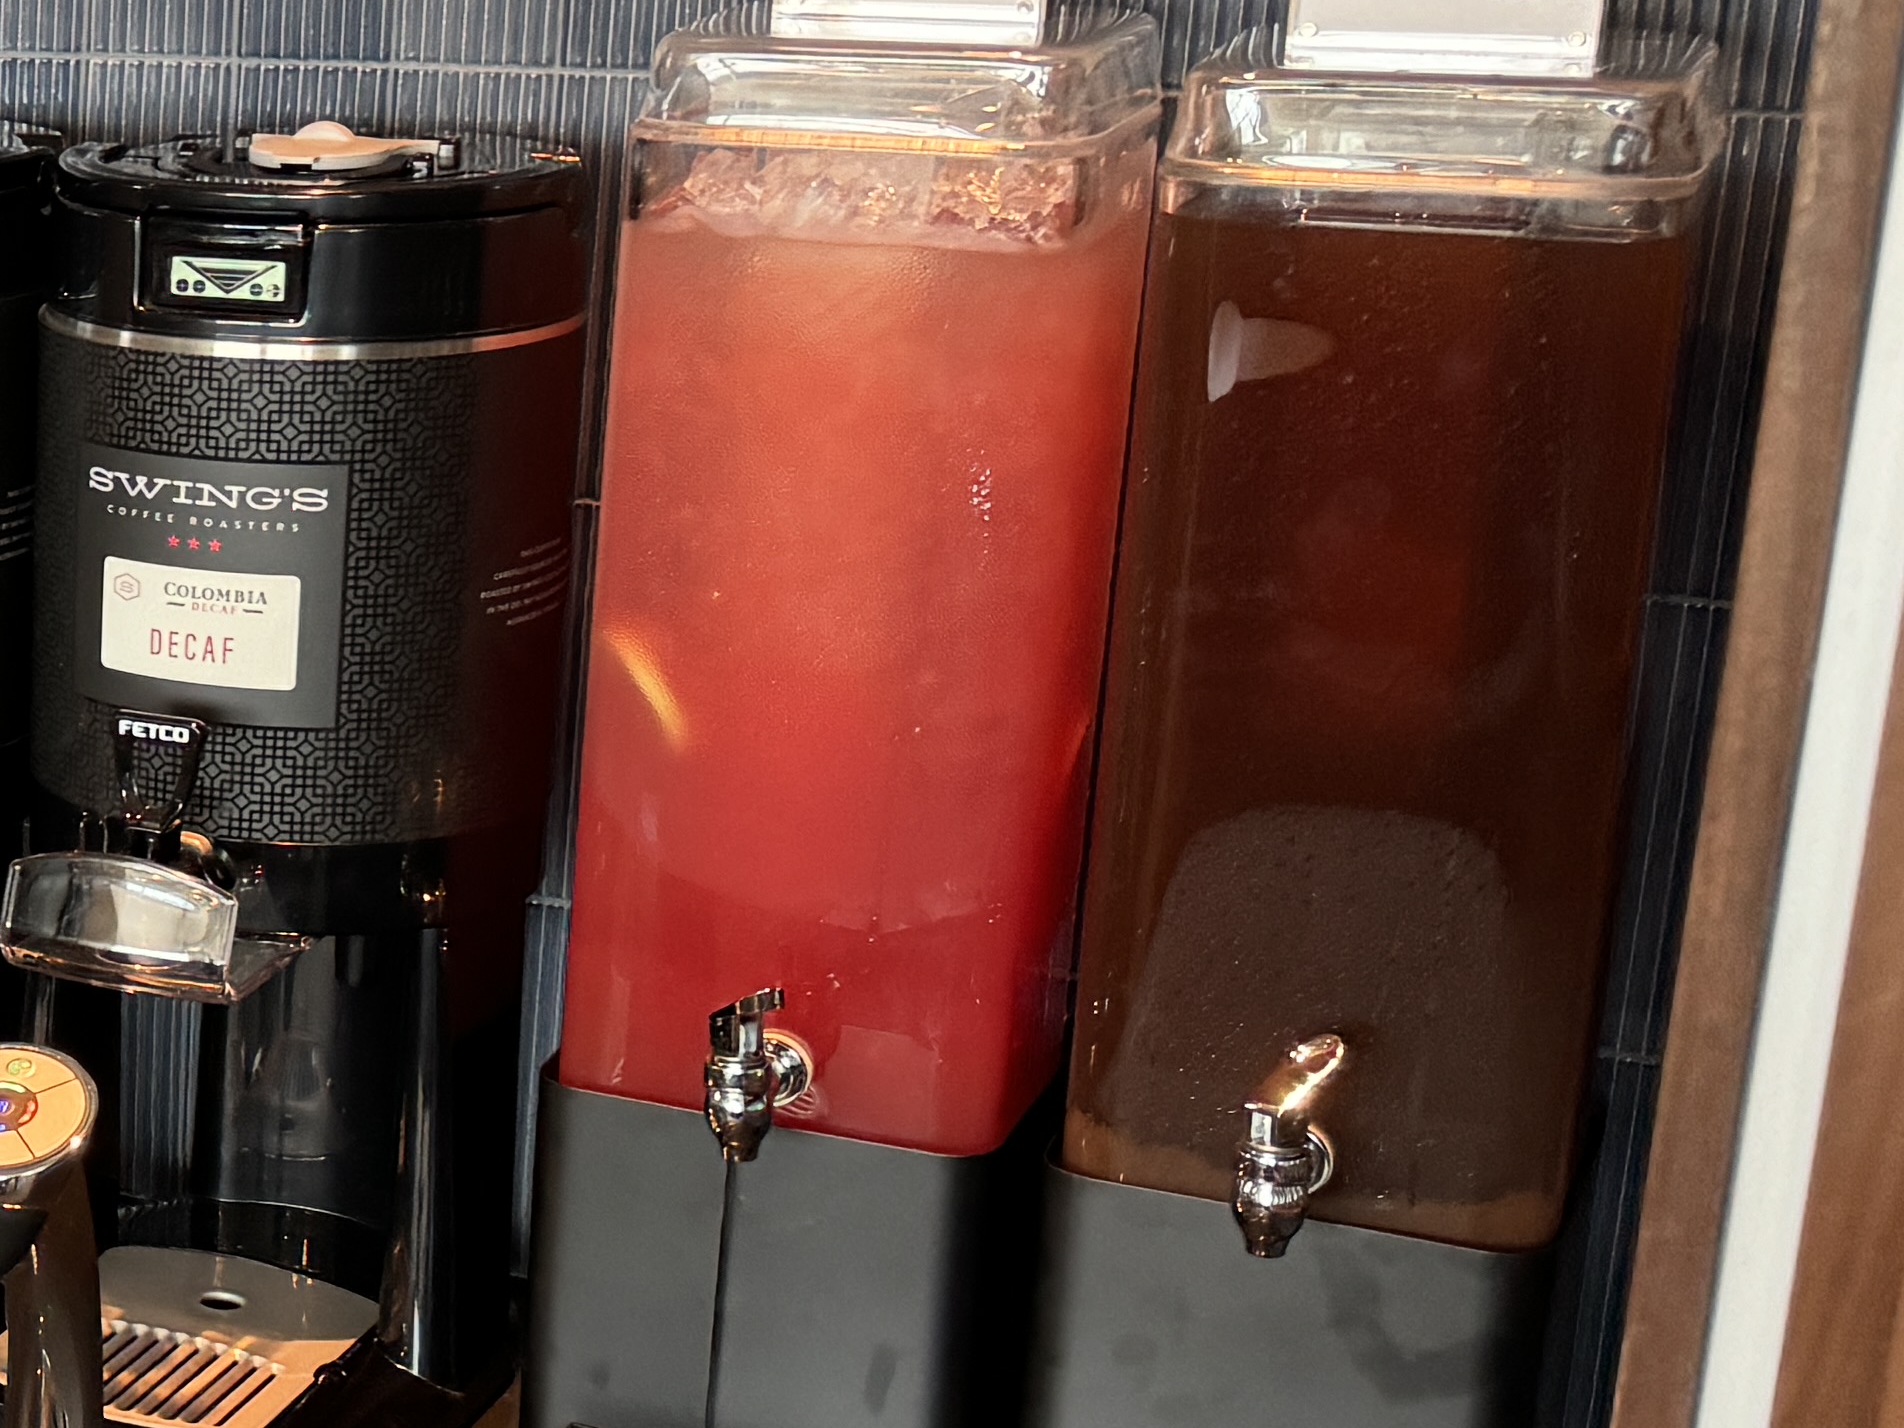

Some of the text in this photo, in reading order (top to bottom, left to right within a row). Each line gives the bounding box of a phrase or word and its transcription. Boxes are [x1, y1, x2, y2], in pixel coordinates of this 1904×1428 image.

[89, 466, 329, 513] SWING'S
[106, 504, 300, 533] COFFEE ROASTERS
[163, 581, 268, 605] COLOMBIA
[191, 602, 240, 615] DECAF
[150, 628, 235, 665] DECAF
[117, 719, 190, 744] FETCO
